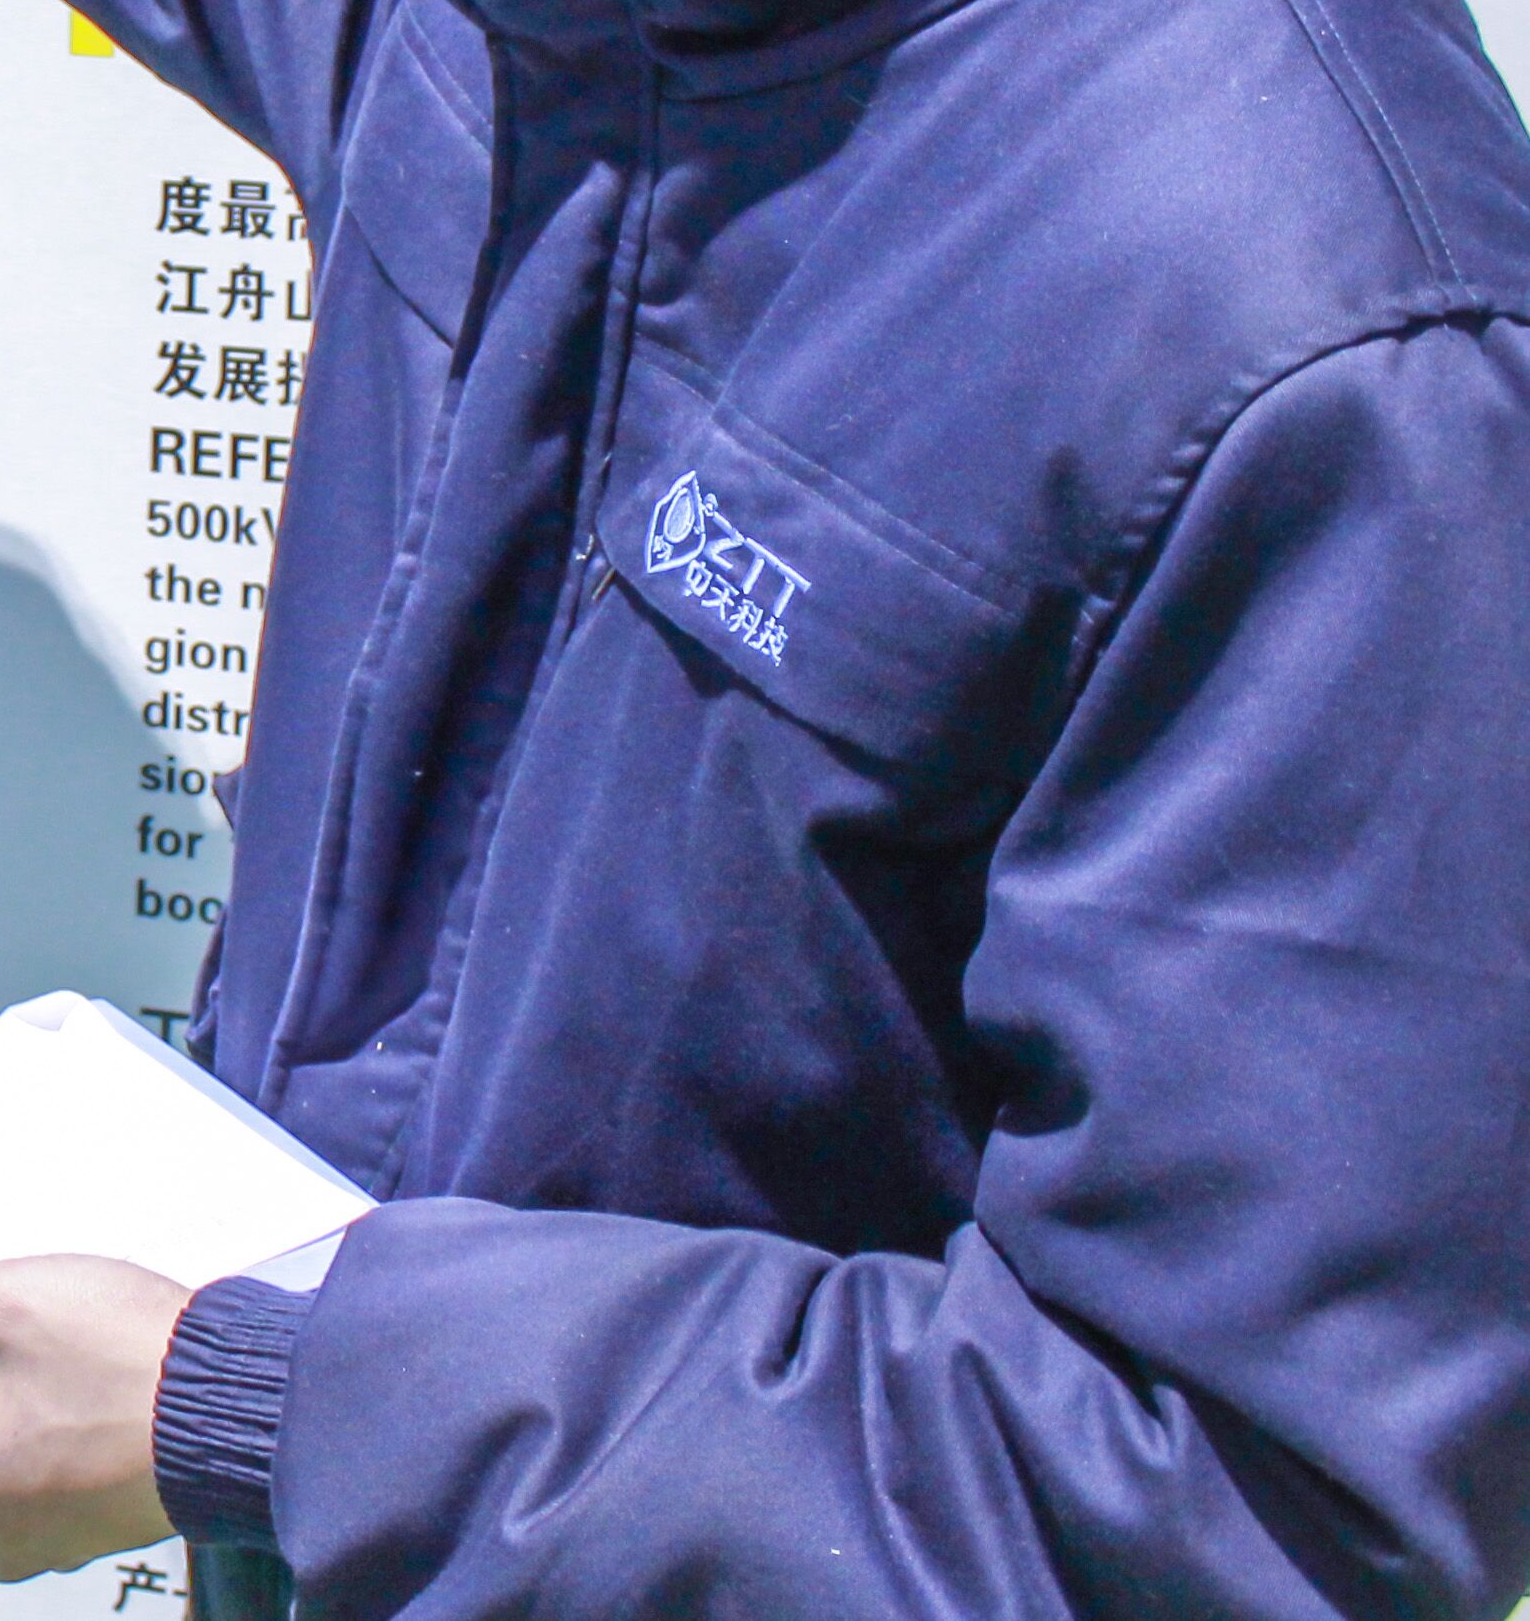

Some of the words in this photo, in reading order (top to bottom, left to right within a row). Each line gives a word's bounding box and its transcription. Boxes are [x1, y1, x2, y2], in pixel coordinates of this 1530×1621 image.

[150, 427, 291, 483] REFE
[144, 563, 221, 606] the
[703, 510, 812, 618] ZTT
[145, 628, 247, 674] gion
[142, 691, 249, 737] distr
[140, 756, 220, 797] sio
[138, 815, 204, 860] for
[113, 1561, 188, 1612] 产
